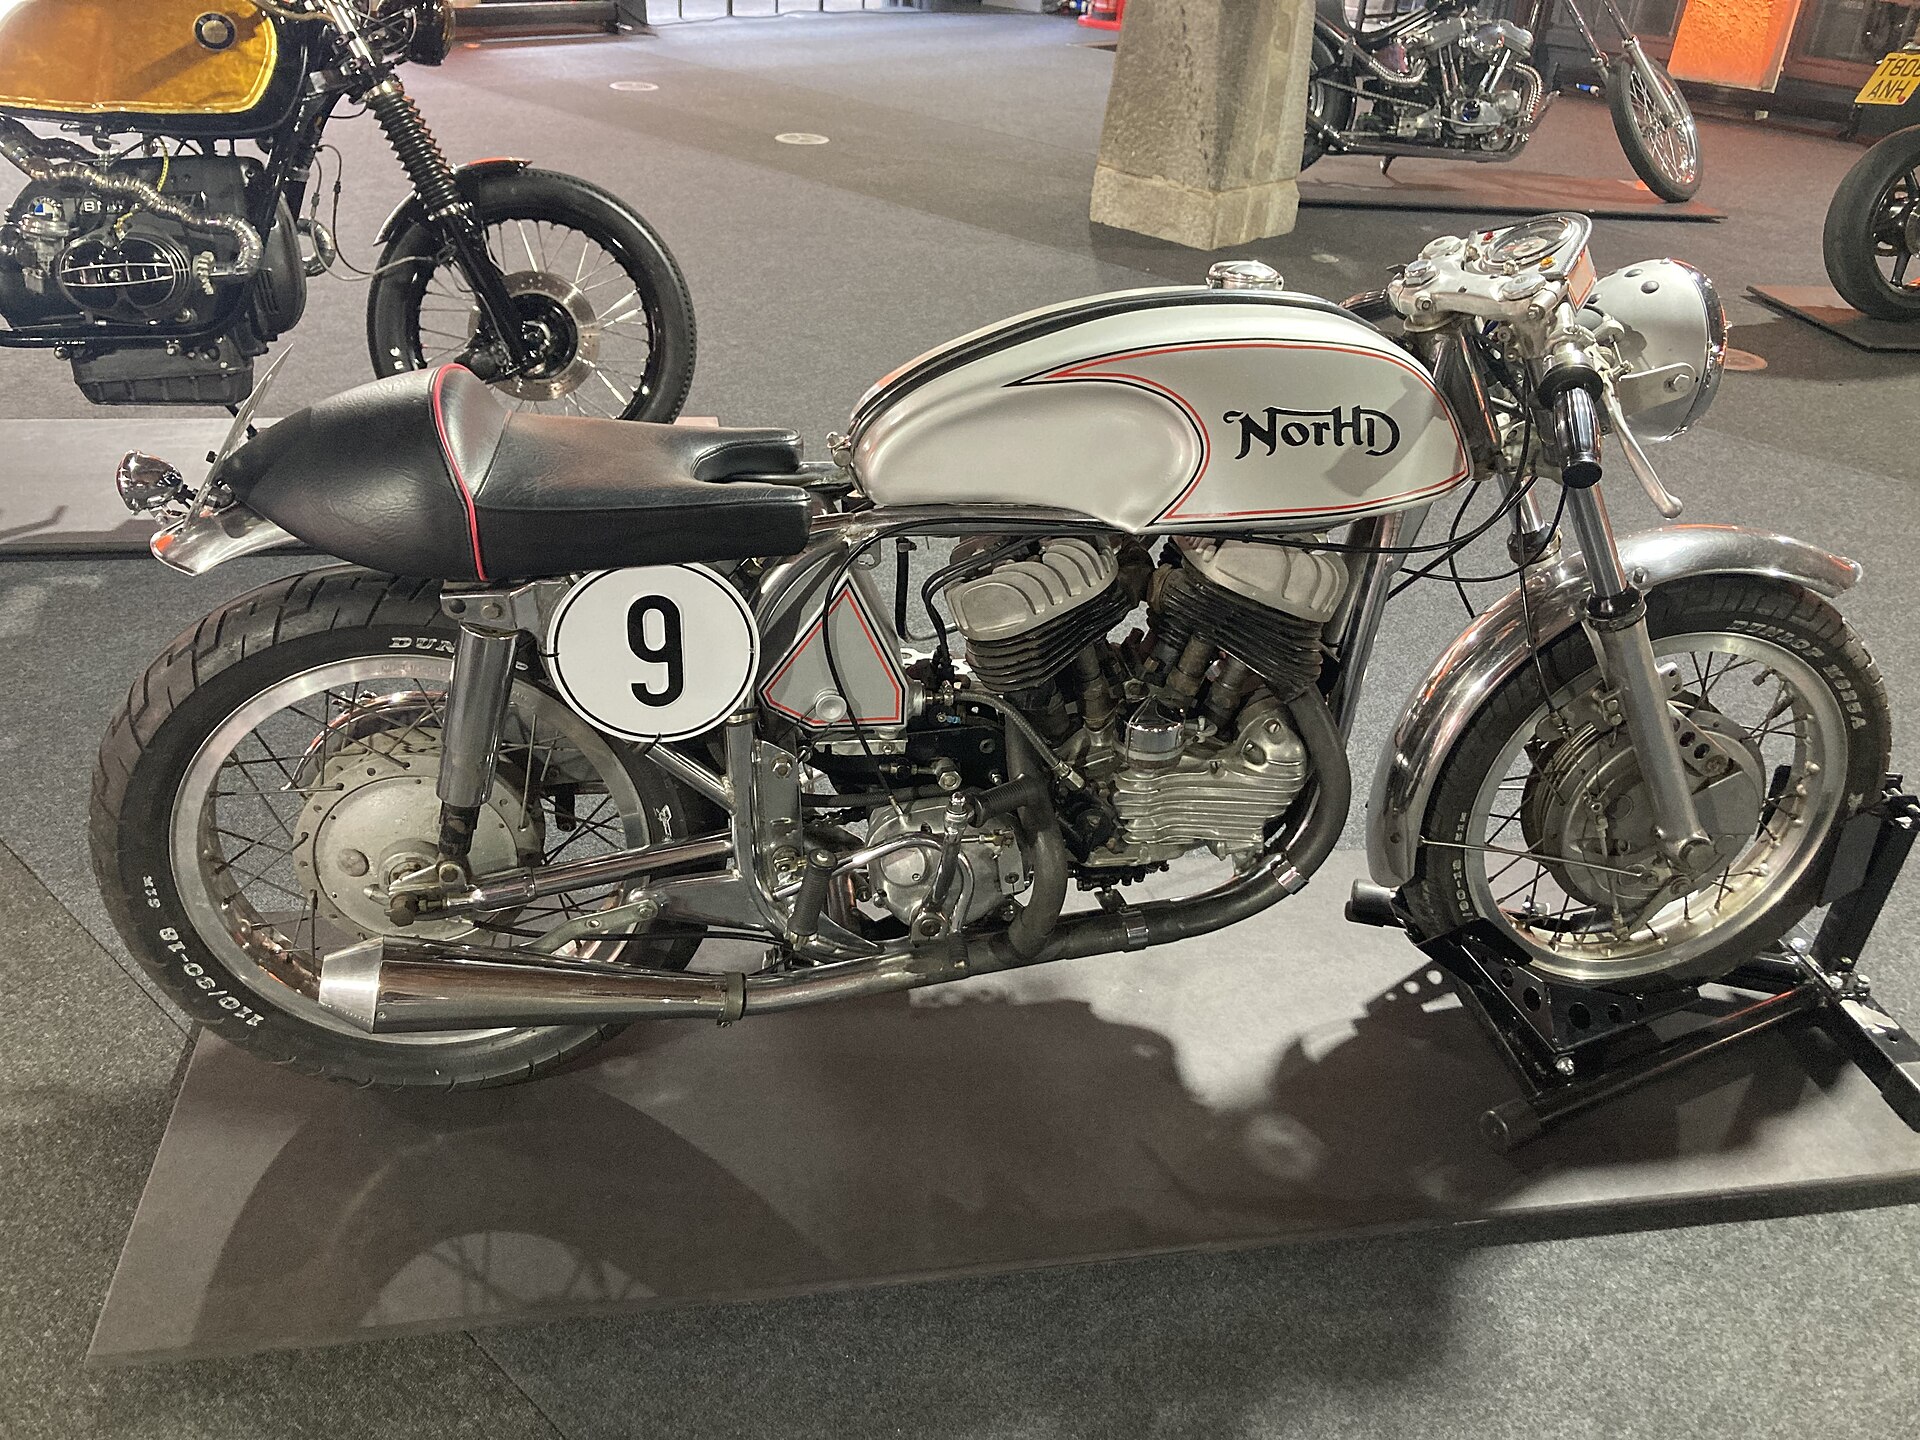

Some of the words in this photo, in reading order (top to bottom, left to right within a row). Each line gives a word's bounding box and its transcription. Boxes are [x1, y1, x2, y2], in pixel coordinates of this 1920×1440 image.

[1867, 80, 1911, 99] ANH
[627, 594, 684, 708] 9
[1725, 620, 1825, 658] DUNLOP
[159, 926, 265, 1027] 110/90-18
